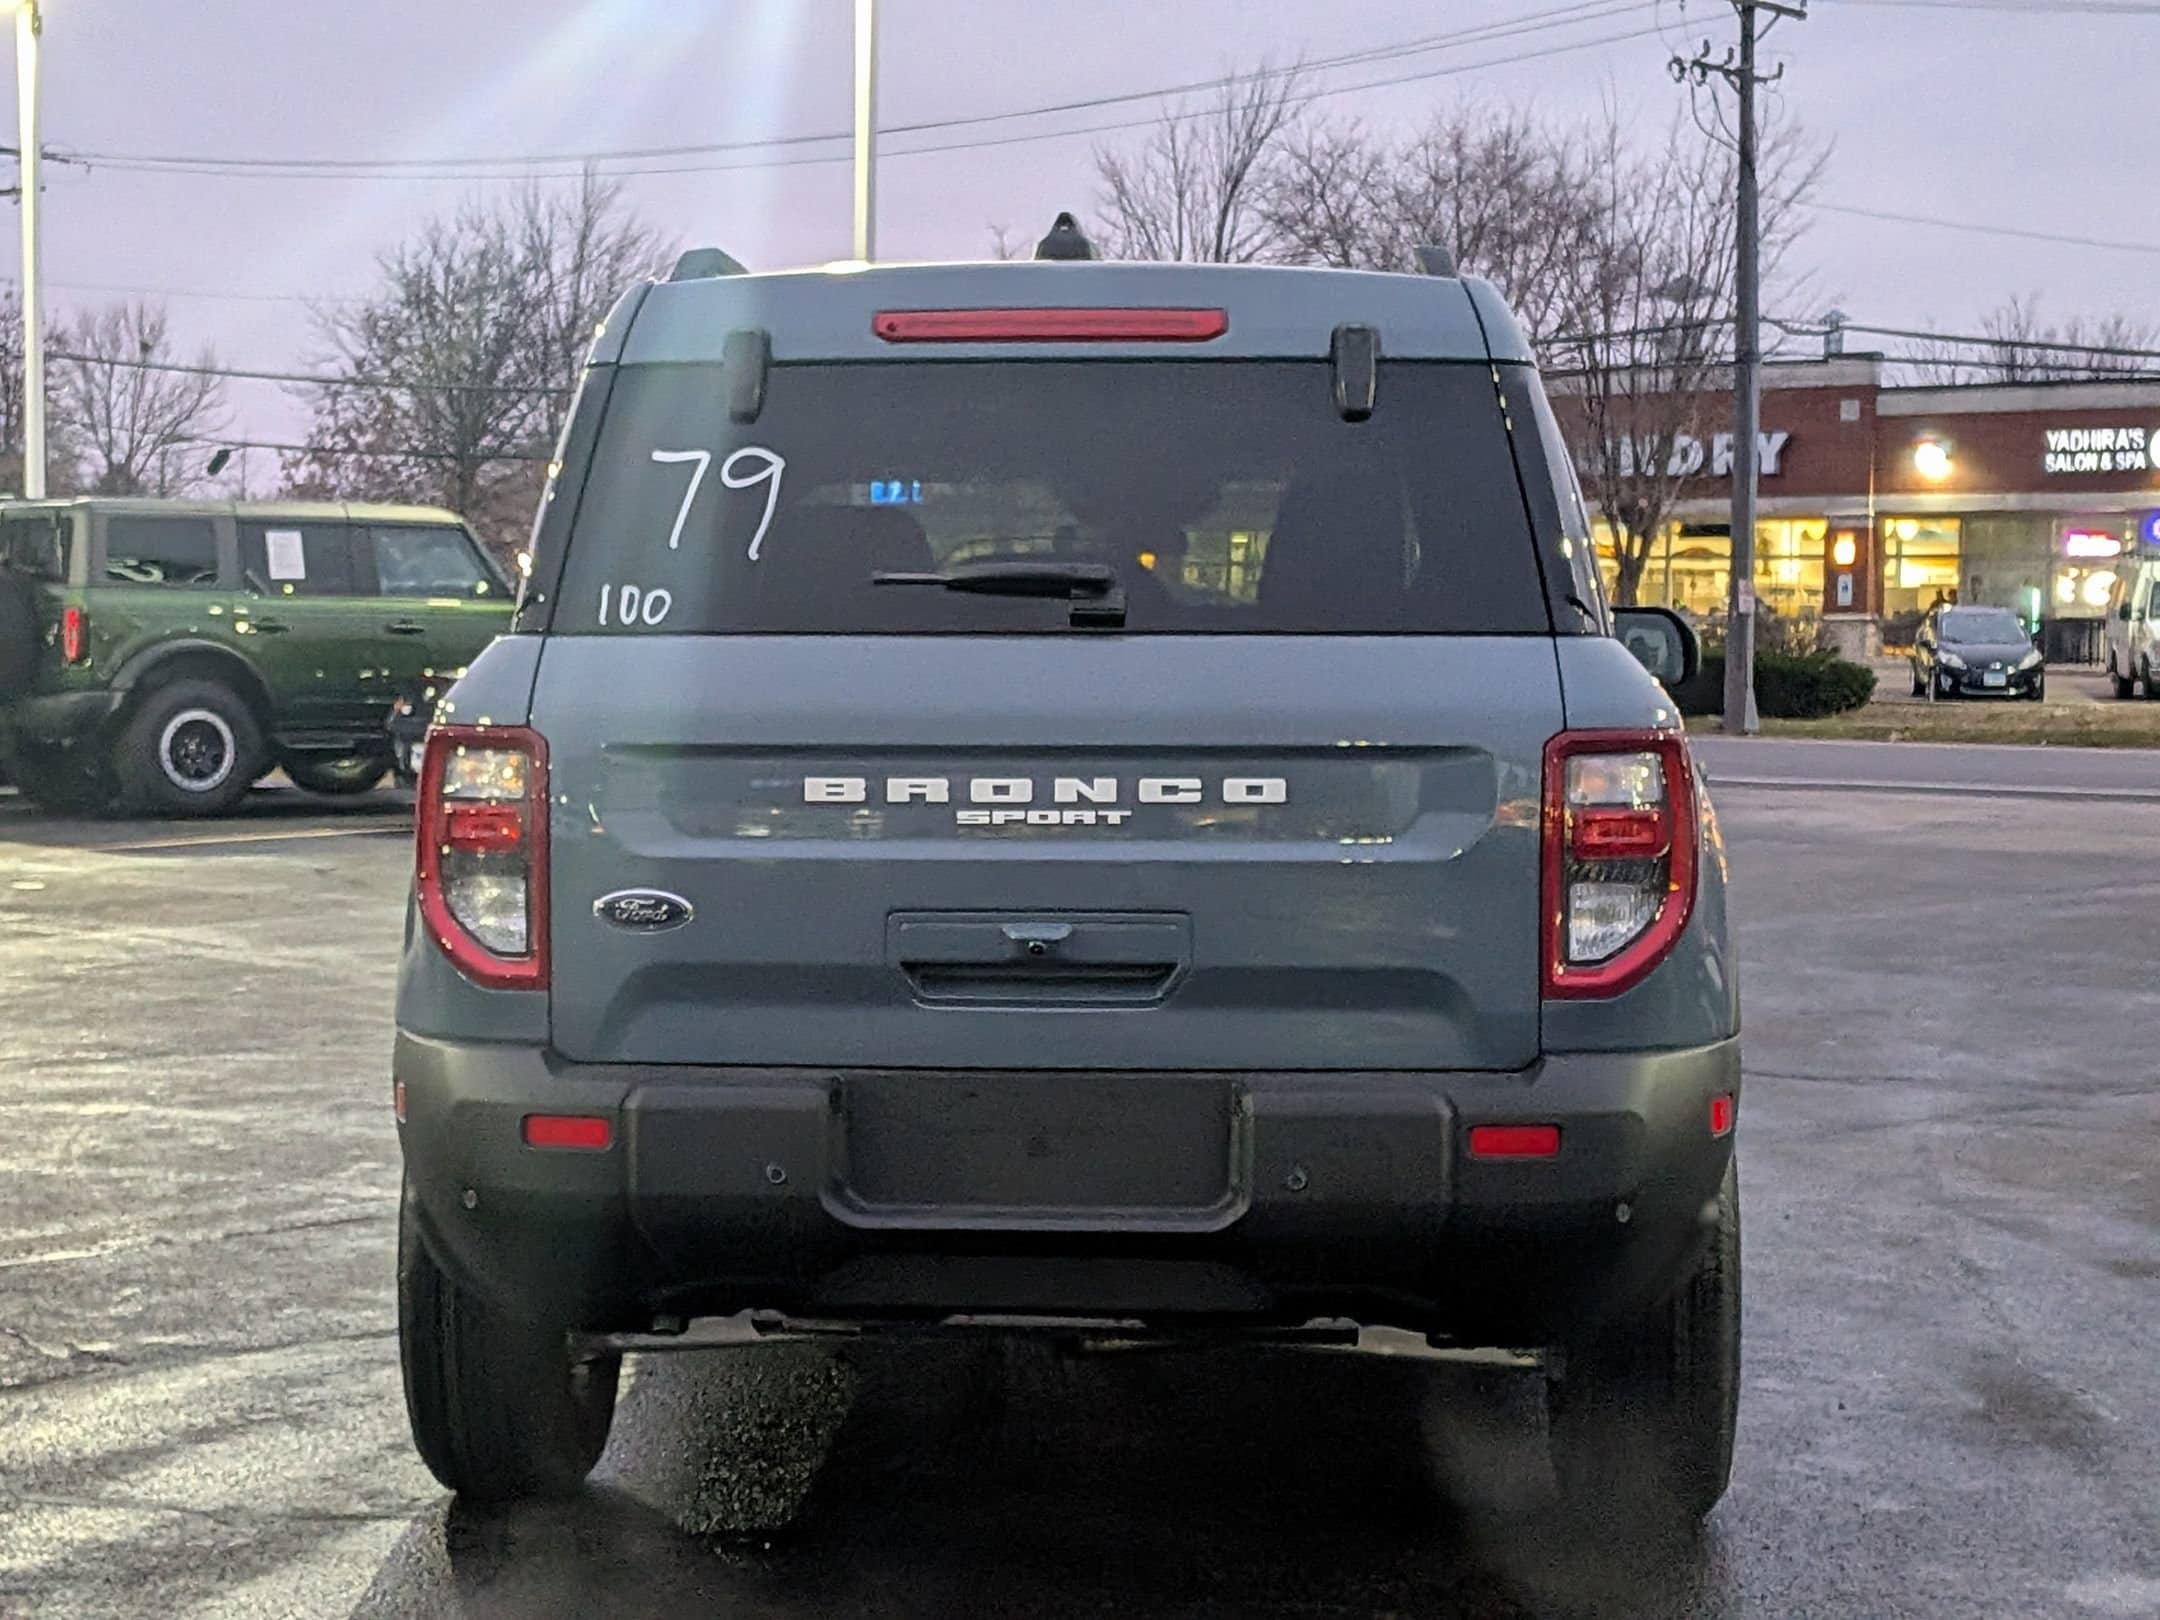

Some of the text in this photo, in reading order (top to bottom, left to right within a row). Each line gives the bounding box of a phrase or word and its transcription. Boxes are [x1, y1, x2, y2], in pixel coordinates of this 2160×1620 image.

[2045, 428, 2146, 452] YADHIRA'S
[2045, 450, 2146, 472] SALON & SPA
[651, 447, 786, 560] 79
[599, 583, 672, 625] 100
[803, 777, 1288, 803] BRONCO
[956, 810, 1132, 825] SPORT
[615, 898, 669, 920] Ford
